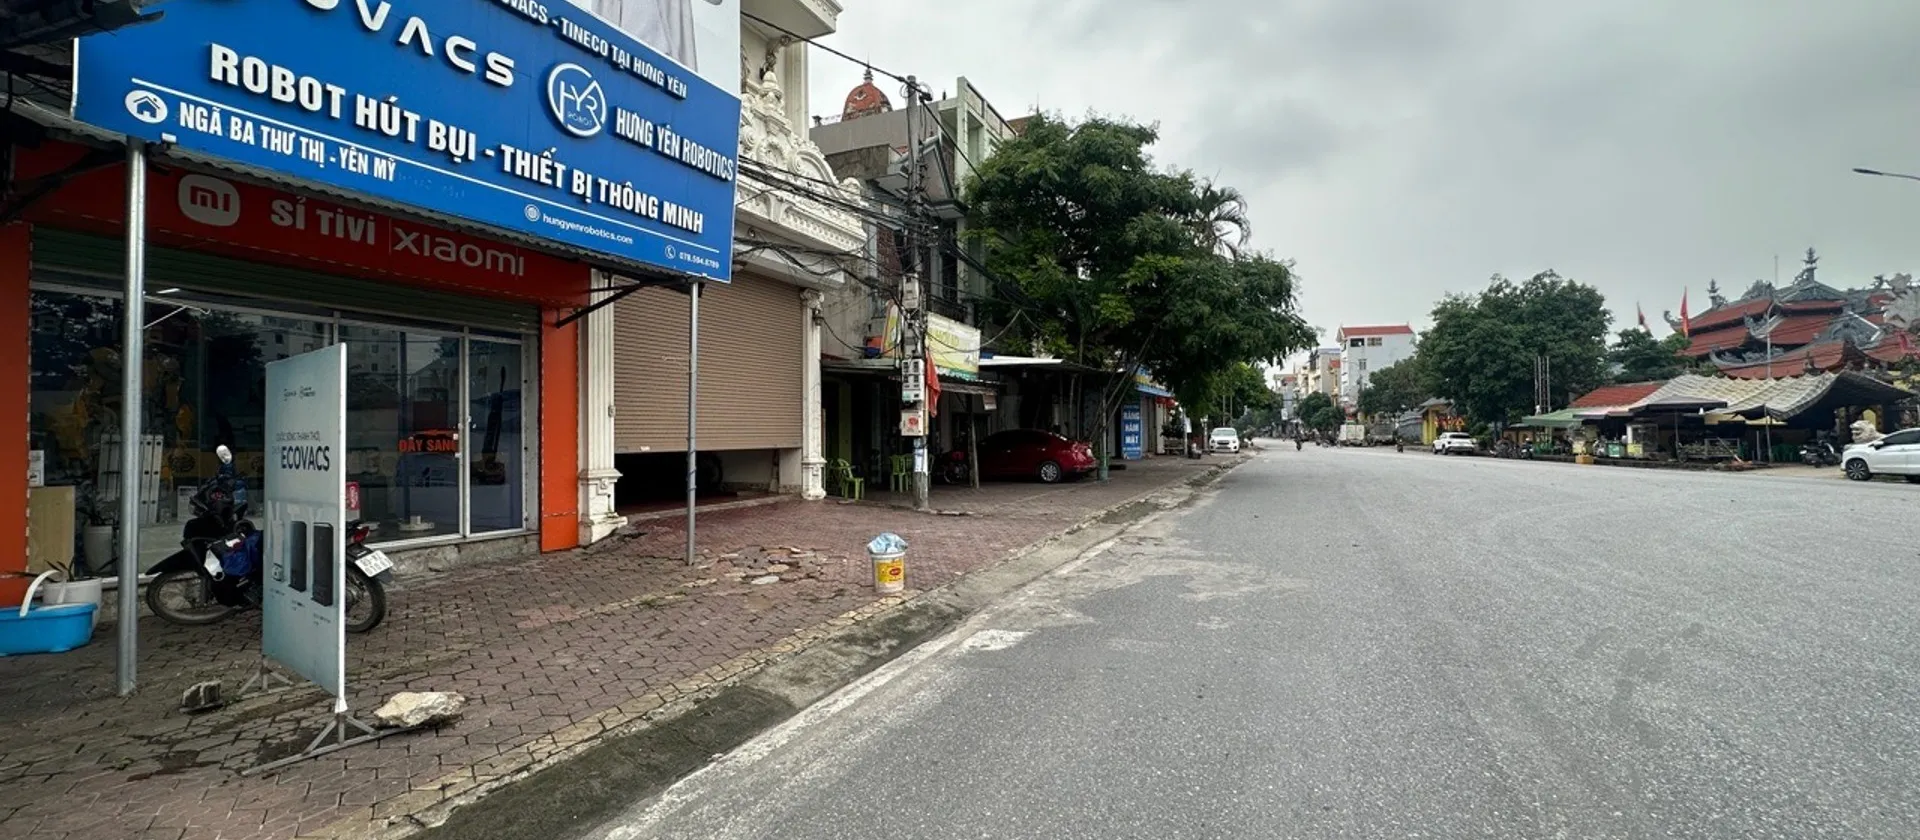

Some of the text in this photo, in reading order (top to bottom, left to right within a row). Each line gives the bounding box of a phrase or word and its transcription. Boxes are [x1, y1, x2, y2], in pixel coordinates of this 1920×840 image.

[560, 17, 608, 56] TINECO
[611, 46, 630, 68] TẠI
[633, 52, 665, 87] HƯNG
[666, 71, 687, 99] YÊN
[179, 101, 222, 137] NGÃ
[230, 115, 255, 145] BA
[260, 125, 296, 156] THƯ
[299, 136, 324, 168] THỊ
[339, 145, 368, 175] YÊN
[374, 157, 396, 182] MỸ
[211, 43, 346, 119] ROBOT
[355, 95, 421, 143] HÚT
[429, 119, 476, 163] BỤI
[501, 144, 566, 189] THIẾT
[572, 168, 592, 203] BỊ
[598, 178, 659, 220] THÔNG
[663, 201, 703, 234] MINH
[616, 106, 734, 182] HƯNG YÊN ROBOTICS
[543, 213, 633, 245] hungyenrobotics.com
[281, 445, 330, 472] ECOVACS
